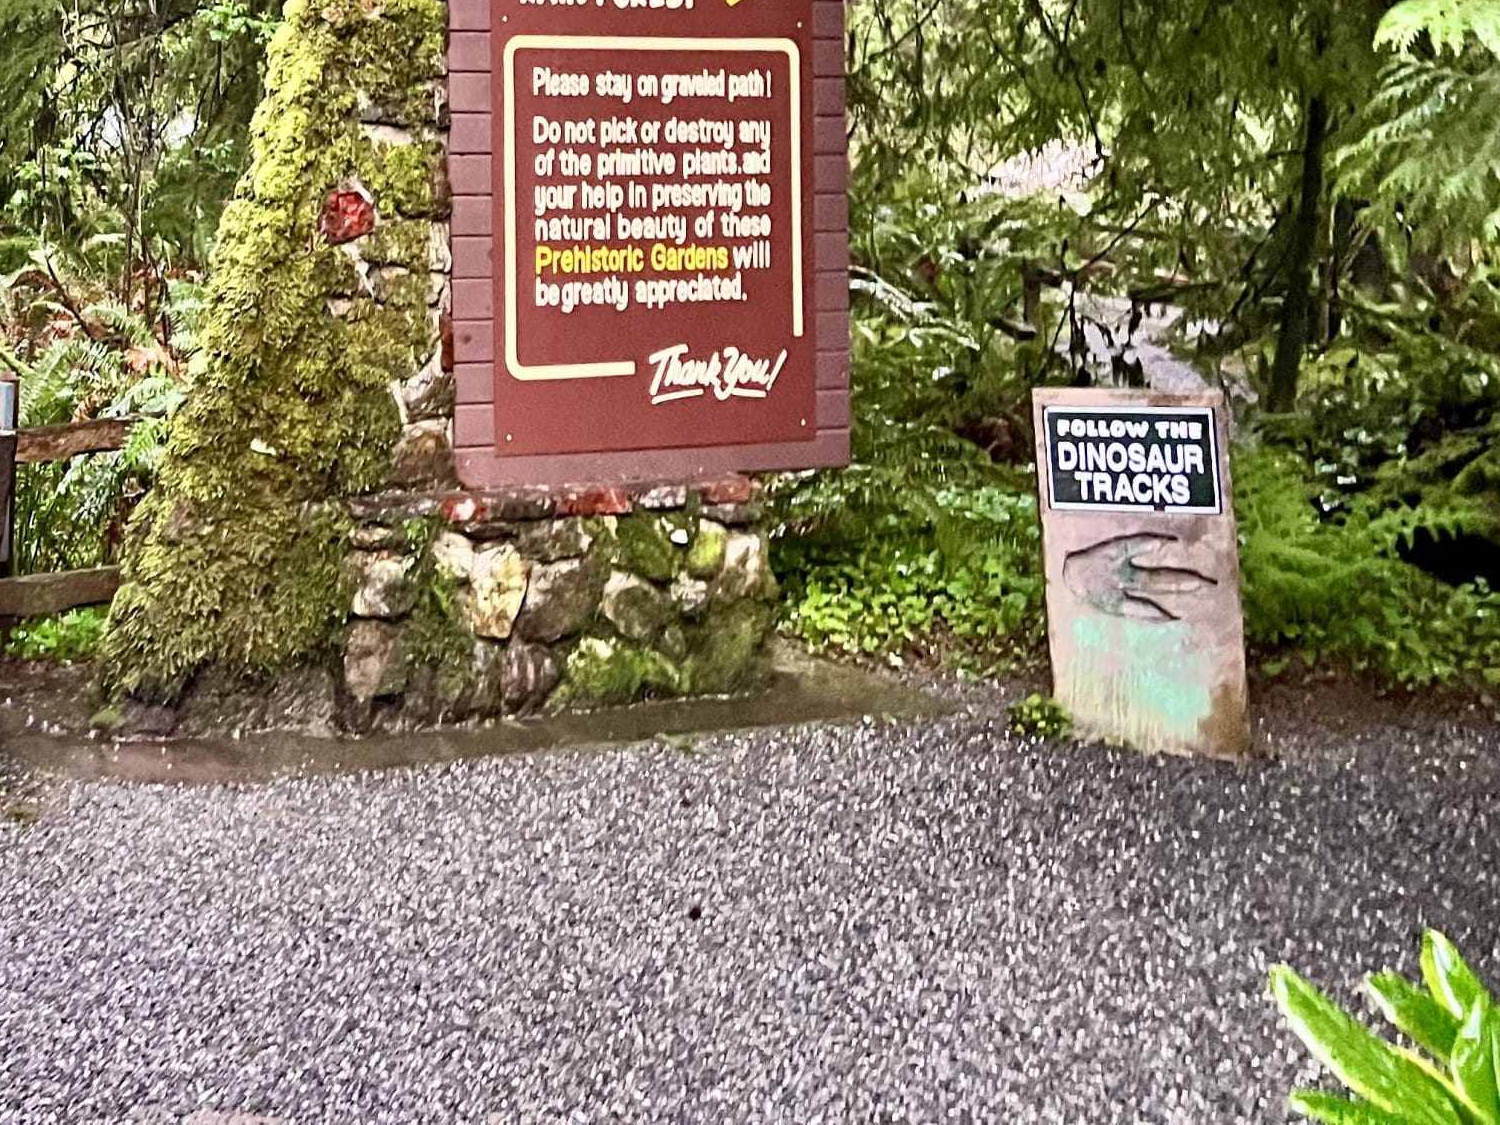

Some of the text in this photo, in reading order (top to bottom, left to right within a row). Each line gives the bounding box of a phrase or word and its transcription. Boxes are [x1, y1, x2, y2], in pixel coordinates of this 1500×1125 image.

[532, 66, 590, 96] Please
[595, 69, 632, 103] stay
[637, 73, 658, 96] on
[661, 69, 725, 103] graveled
[532, 116, 771, 149] Do not pick or destroy any
[534, 148, 555, 176] of
[559, 149, 592, 175] the
[597, 148, 676, 179] primitive
[534, 178, 771, 216] your help in preserving the
[534, 210, 771, 244] natural beauty of these
[535, 240, 771, 274] Prehistoric Gardens will
[535, 277, 559, 306] be
[561, 277, 629, 313] greatly
[649, 344, 722, 396] Thank
[1057, 419, 1203, 440] FOLLOW THE
[1057, 441, 1205, 474] DINOSAUR
[1074, 471, 1191, 505] TRACKS
